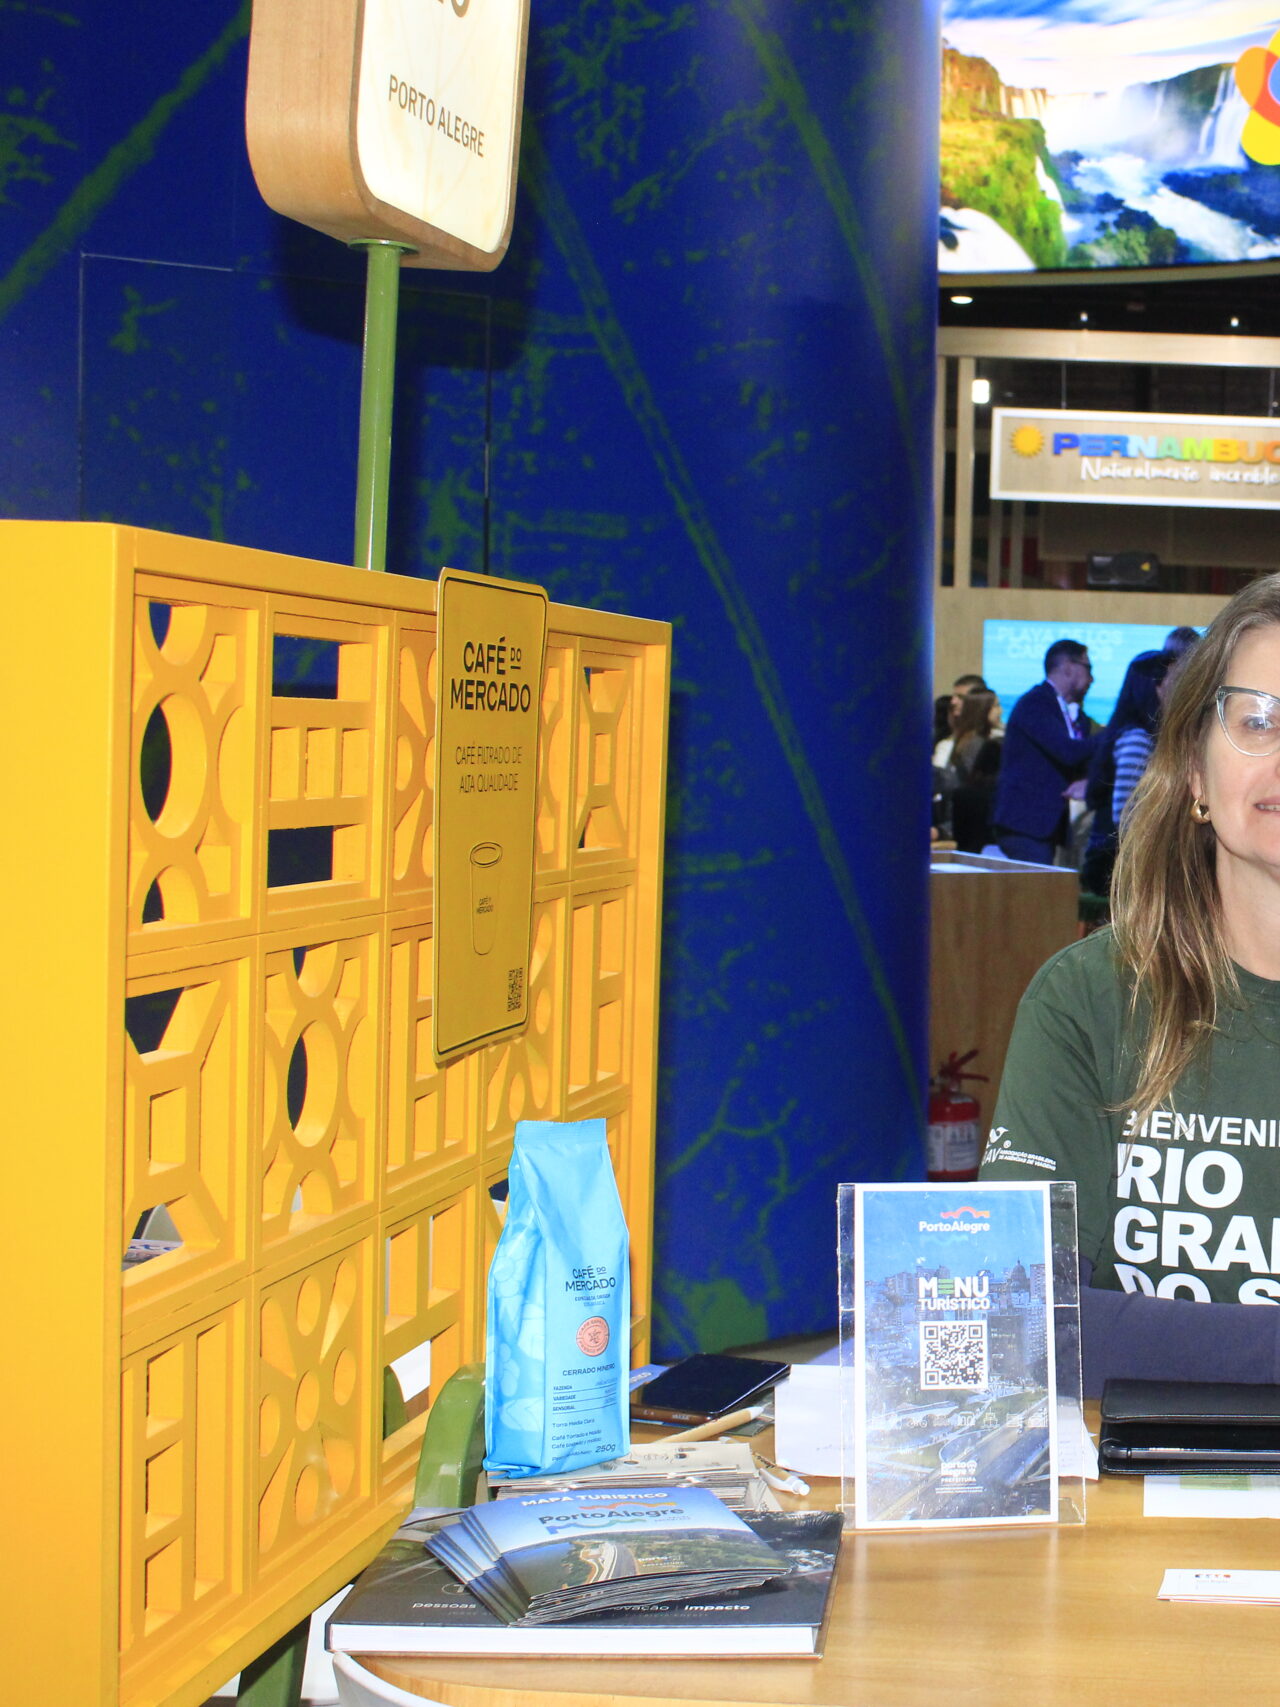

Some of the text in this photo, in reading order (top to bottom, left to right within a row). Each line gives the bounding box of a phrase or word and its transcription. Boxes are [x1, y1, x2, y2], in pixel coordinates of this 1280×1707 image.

[388, 74, 485, 158] PORTO ALEGRE
[1080, 457, 1201, 483] Naturalmente
[996, 626, 1051, 643] PLAYA
[463, 636, 522, 675] CAFÉ DO
[450, 677, 531, 713] MERCADO
[455, 742, 522, 765] CAFÉ FILTRADO DE
[459, 773, 519, 793] ALTA QUALIDADE
[1116, 1143, 1244, 1209] RIO
[918, 1220, 990, 1234] PortoAlegre
[572, 1264, 596, 1279] CAFÉ
[565, 1276, 616, 1292] MERCADO
[918, 1270, 989, 1298] MENÚ
[918, 1295, 991, 1311] TURÍSTICO
[562, 1367, 596, 1376] CERRADO
[594, 1443, 616, 1453] 250g
[521, 1496, 574, 1506] MAPA
[538, 1507, 685, 1525] PortoAlegre
[412, 1602, 477, 1611] pessoas
[684, 1604, 751, 1612] impacto
